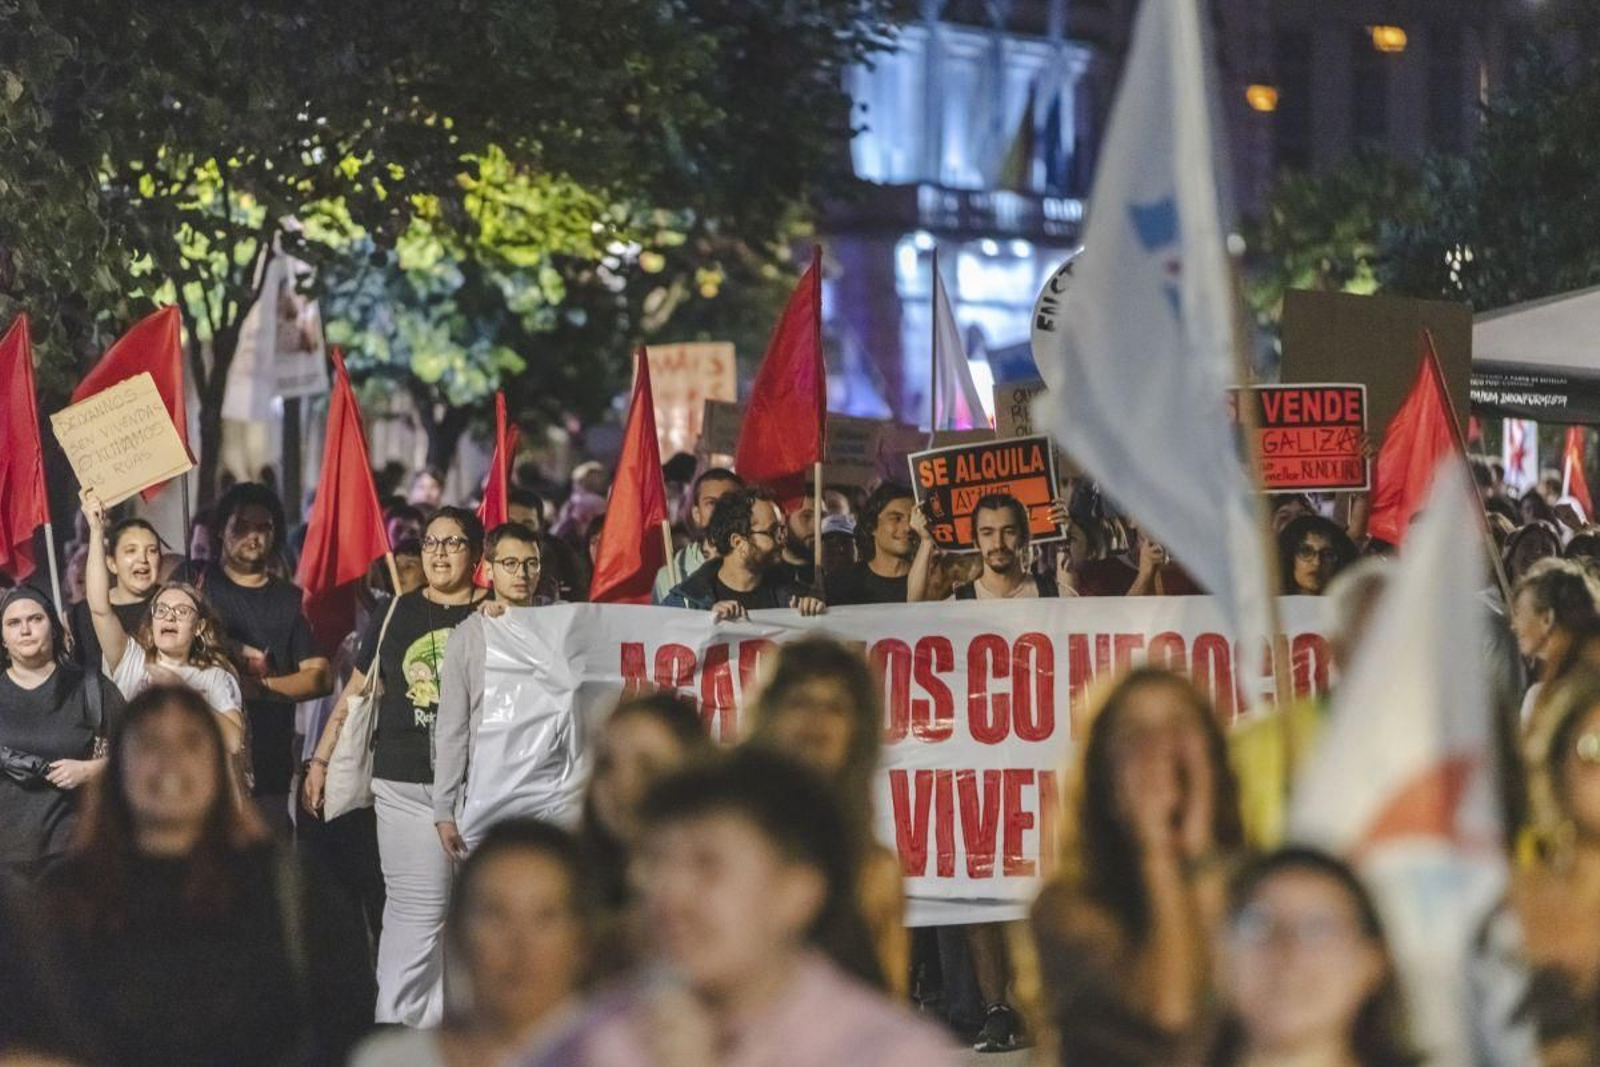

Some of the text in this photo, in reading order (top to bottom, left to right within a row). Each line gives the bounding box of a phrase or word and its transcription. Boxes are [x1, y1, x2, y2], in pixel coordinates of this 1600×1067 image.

[1262, 391, 1360, 423] VENDE
[1262, 428, 1358, 454] GALIZA
[918, 445, 1045, 488] SE ALQUILA
[967, 631, 1056, 745] CO
